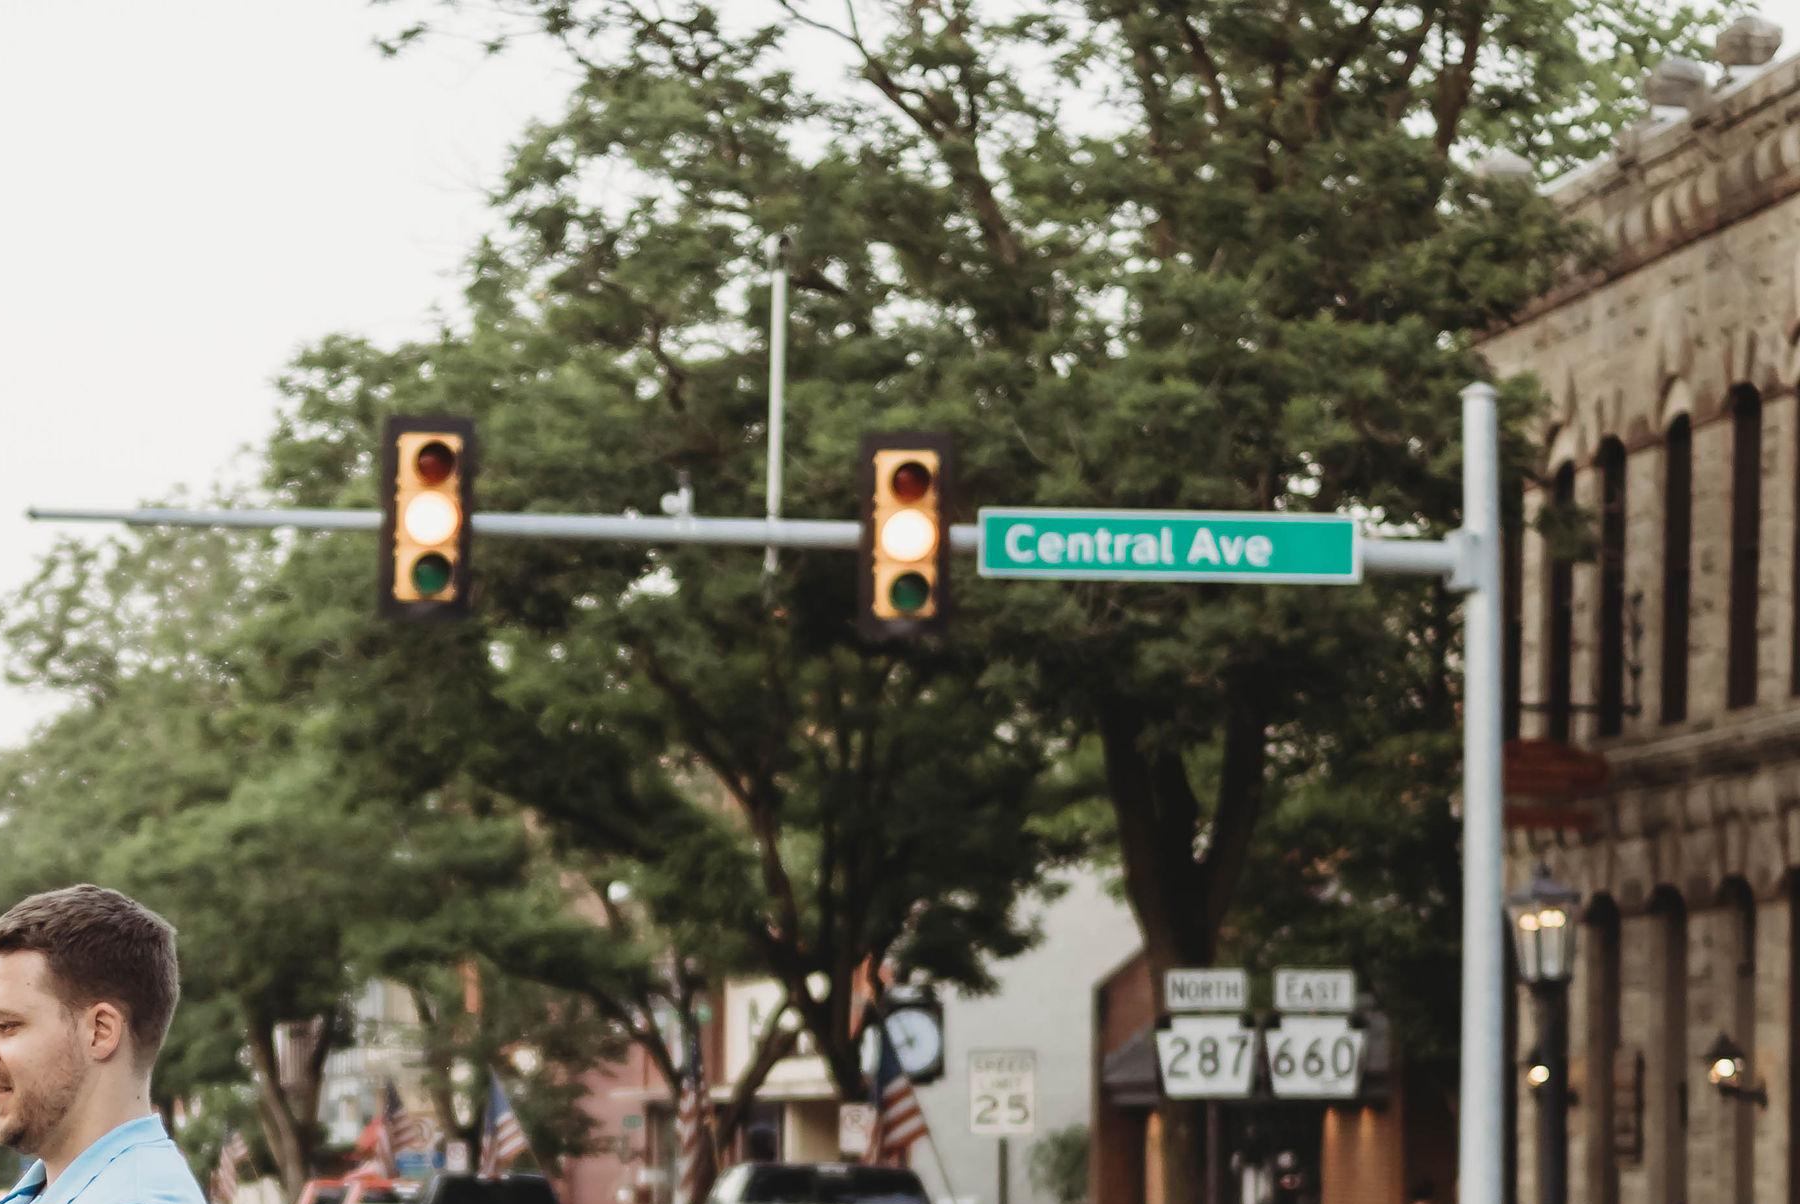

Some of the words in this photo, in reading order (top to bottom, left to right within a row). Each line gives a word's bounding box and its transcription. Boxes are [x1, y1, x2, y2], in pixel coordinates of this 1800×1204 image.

[1004, 523, 1175, 566] Central
[1186, 526, 1274, 567] Ave
[1171, 978, 1239, 999] NORTH
[1285, 975, 1338, 1000] EAST
[1169, 1036, 1248, 1079] 287
[1274, 1036, 1354, 1079] 660
[975, 1094, 1029, 1126] 25
